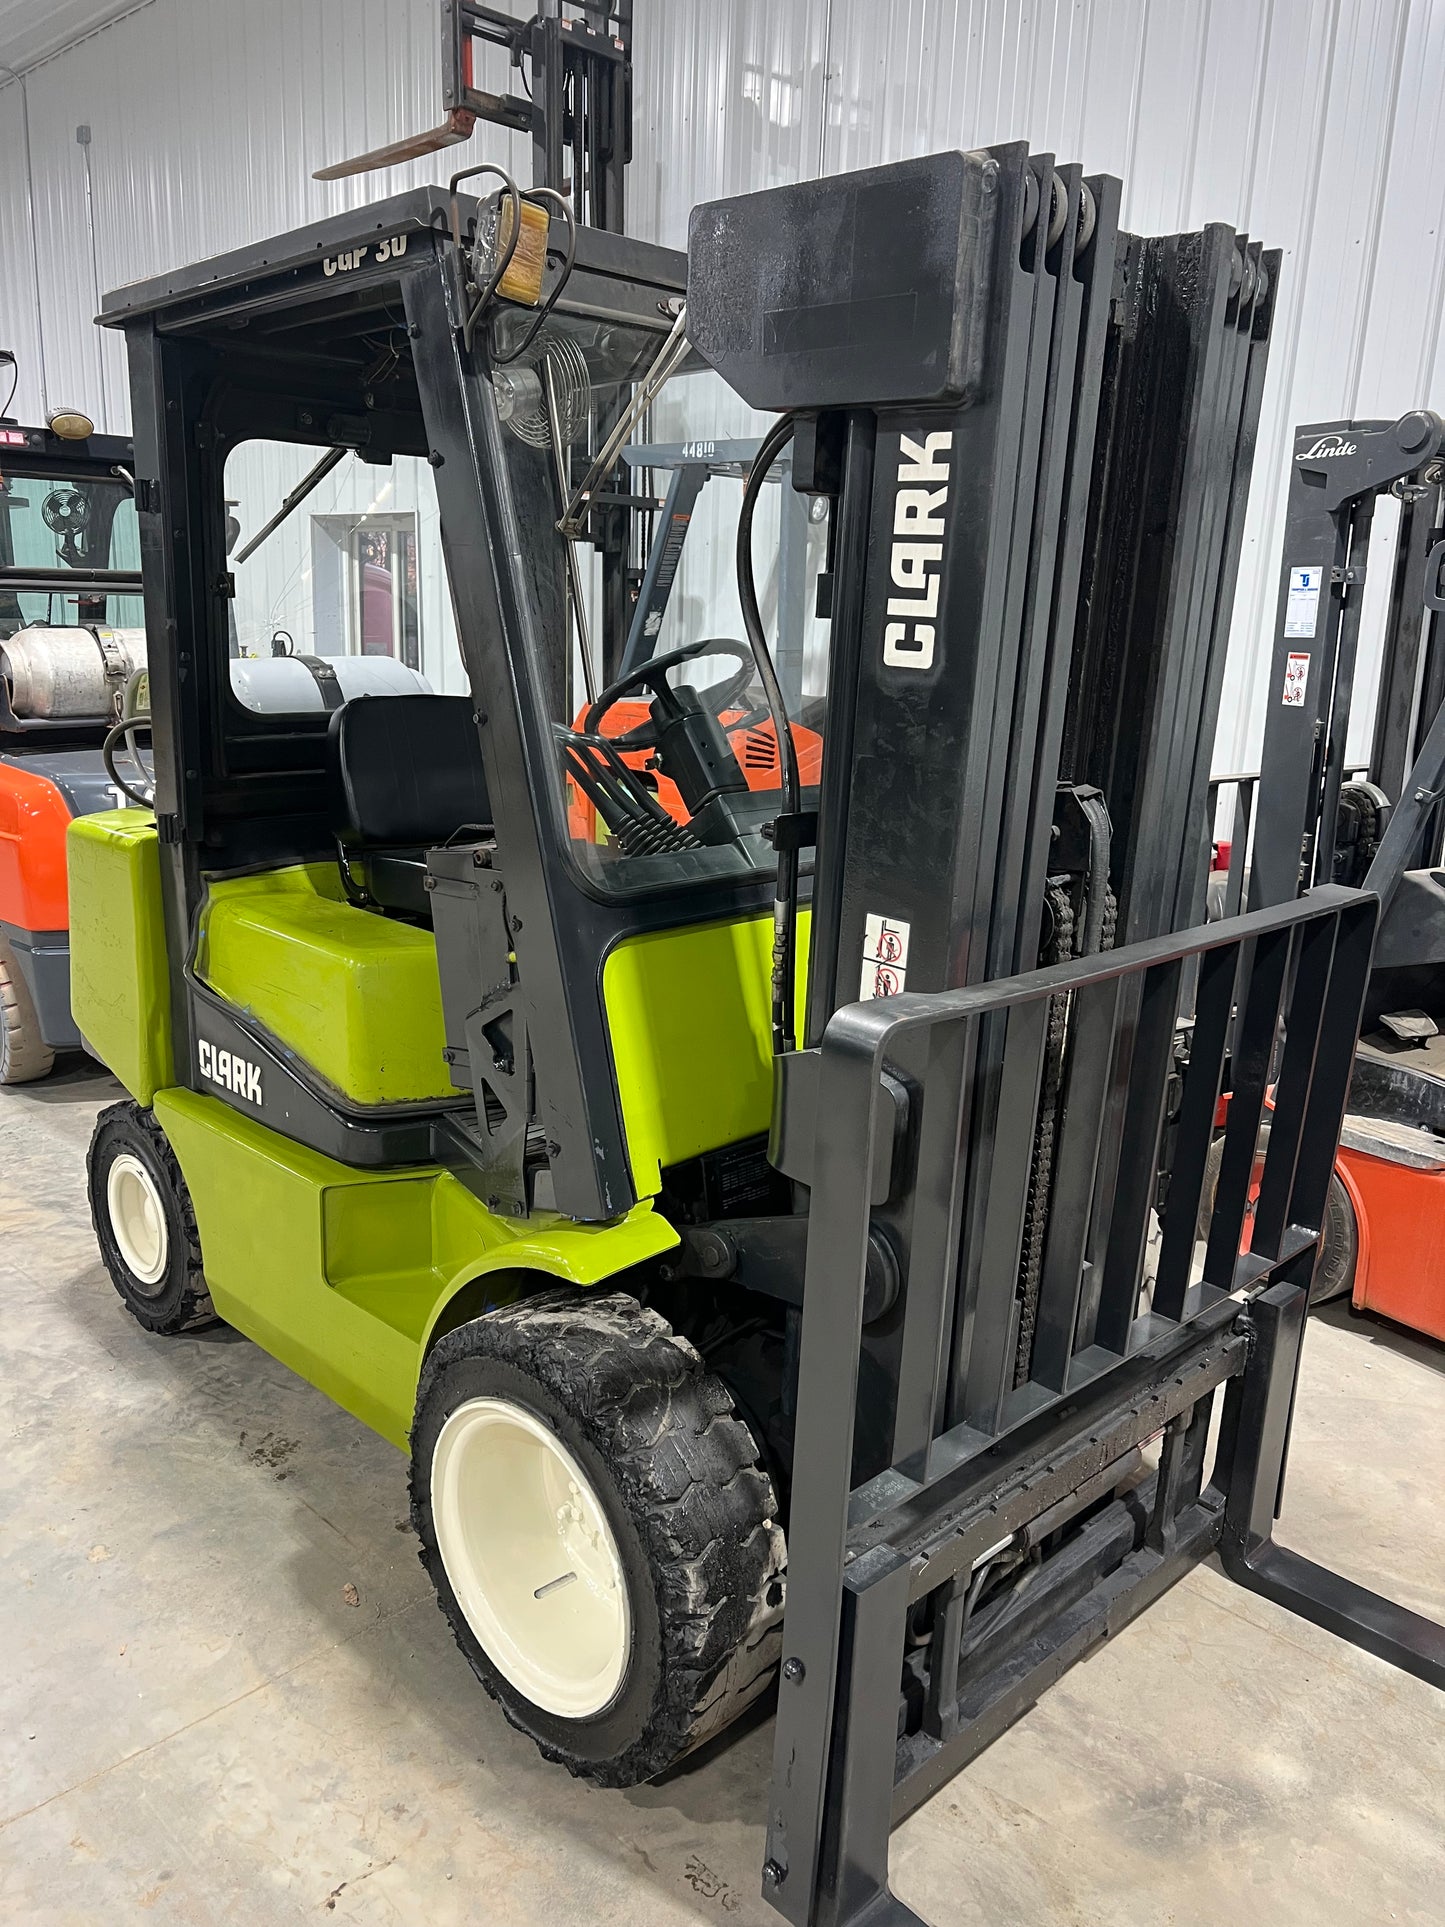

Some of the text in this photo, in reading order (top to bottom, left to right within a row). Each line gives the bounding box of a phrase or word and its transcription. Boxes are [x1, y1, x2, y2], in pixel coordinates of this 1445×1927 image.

[375, 234, 407, 262] 30
[682, 441, 715, 458] 44810
[1295, 435, 1357, 461] Linde
[883, 431, 953, 670] CLARK
[198, 1038, 262, 1106] CLARK
